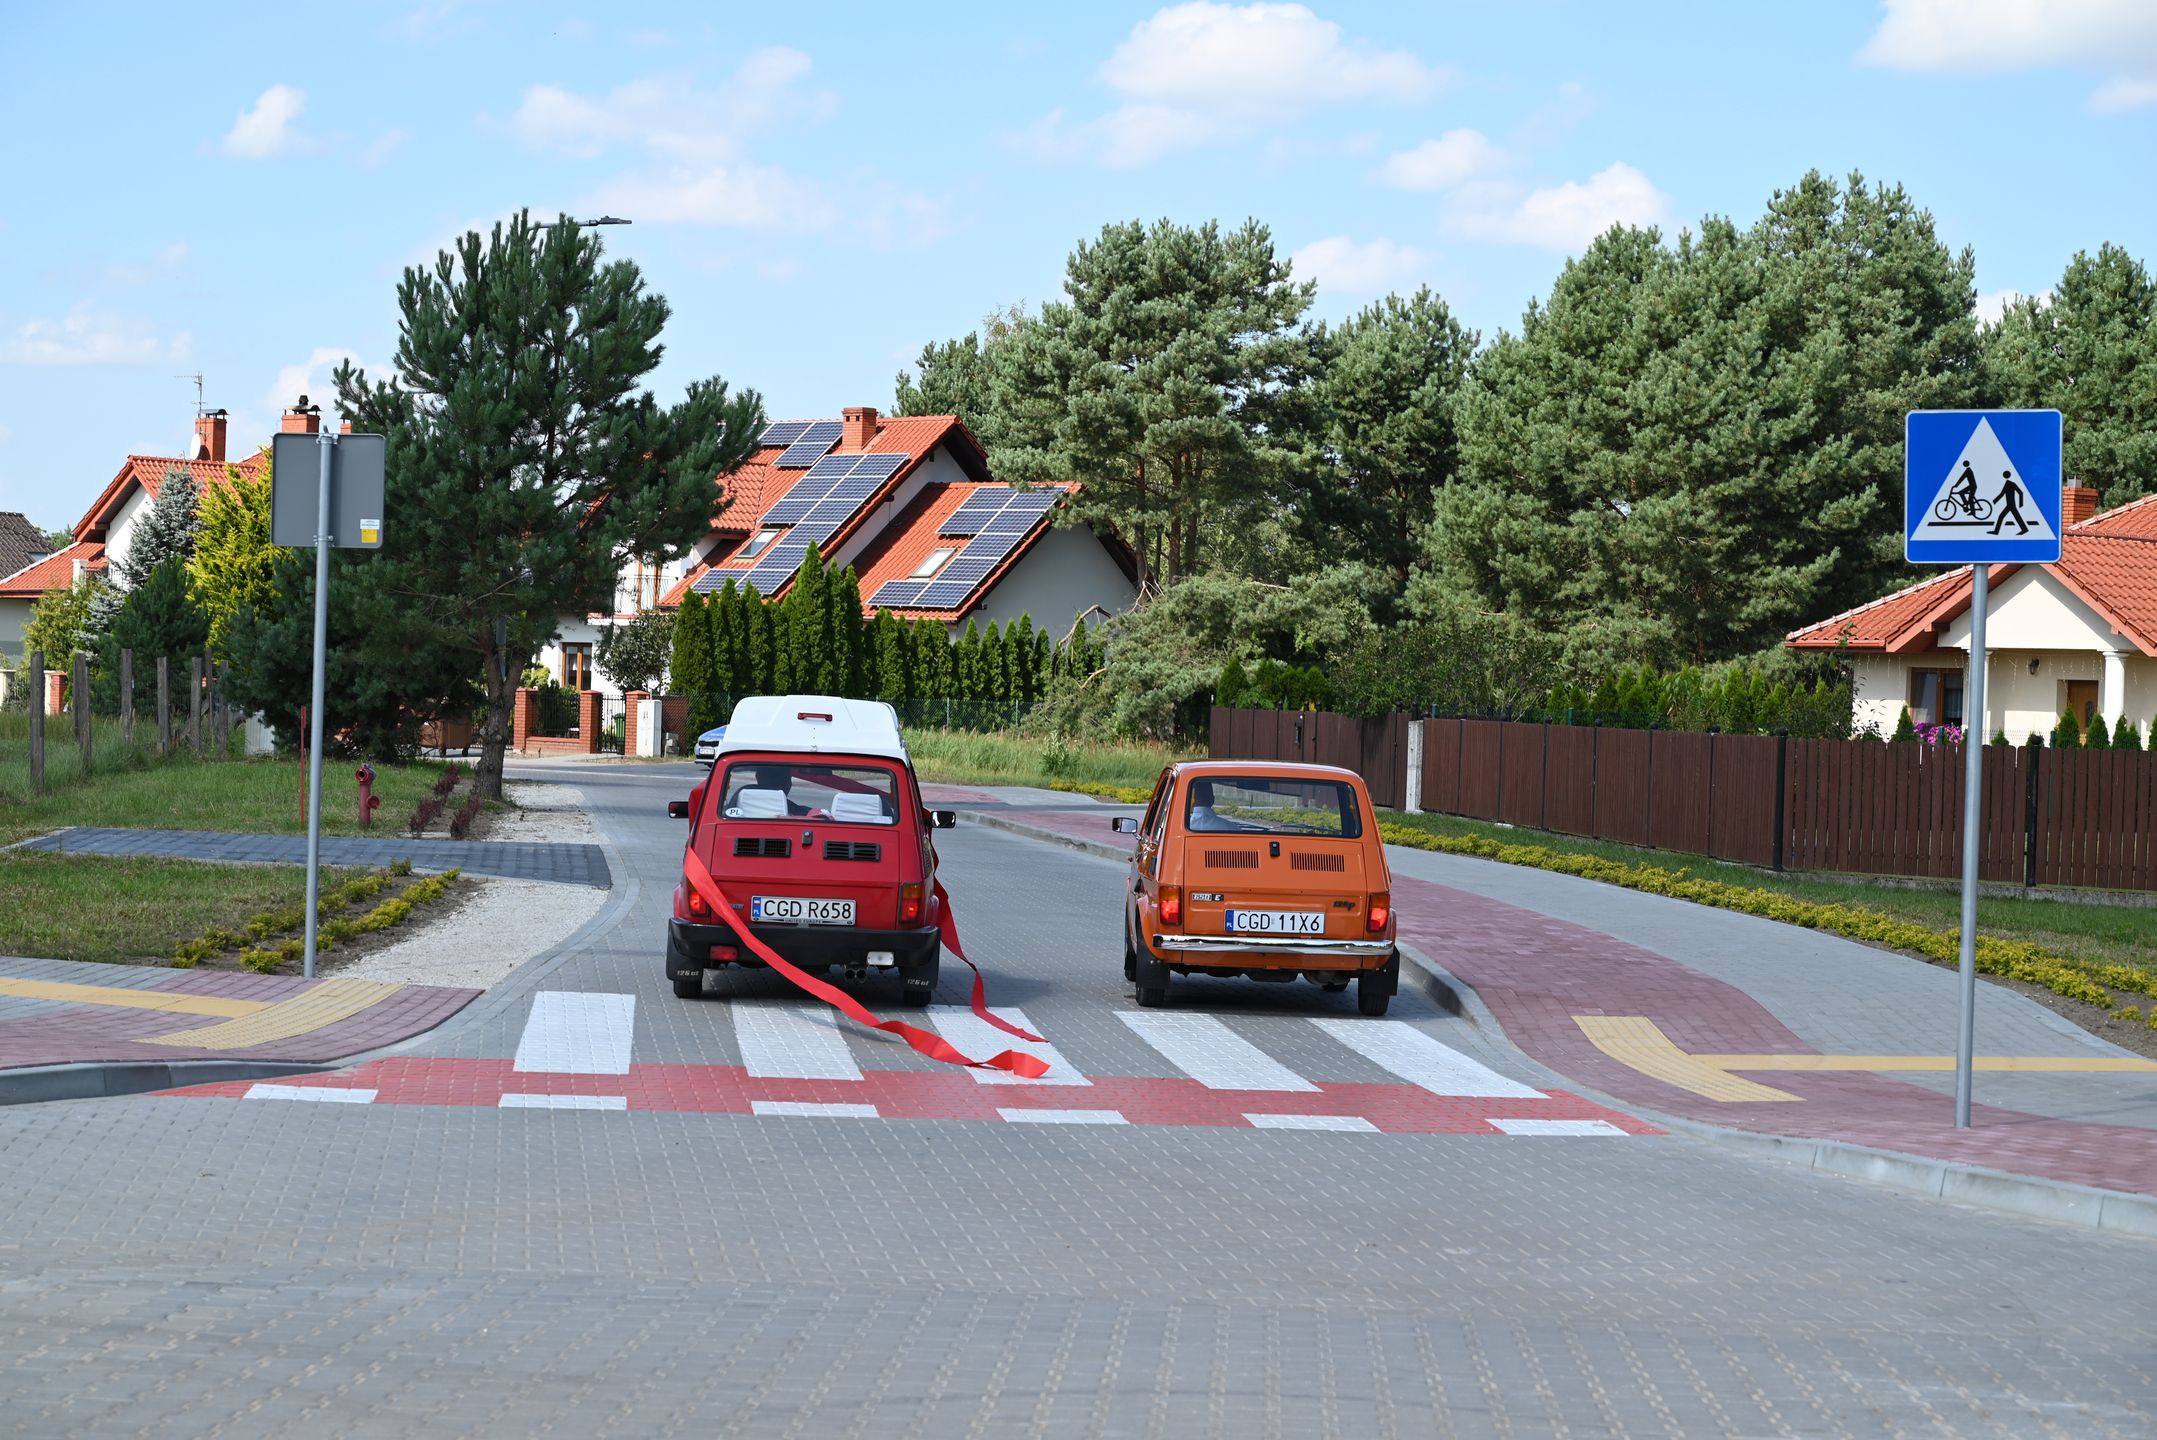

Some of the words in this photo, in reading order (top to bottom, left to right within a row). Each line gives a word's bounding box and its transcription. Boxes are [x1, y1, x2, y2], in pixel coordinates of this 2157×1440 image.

[764, 900, 801, 917] CGD
[808, 902, 851, 919] R658
[1237, 913, 1270, 930] CGD
[1279, 914, 1320, 931] 11X6
